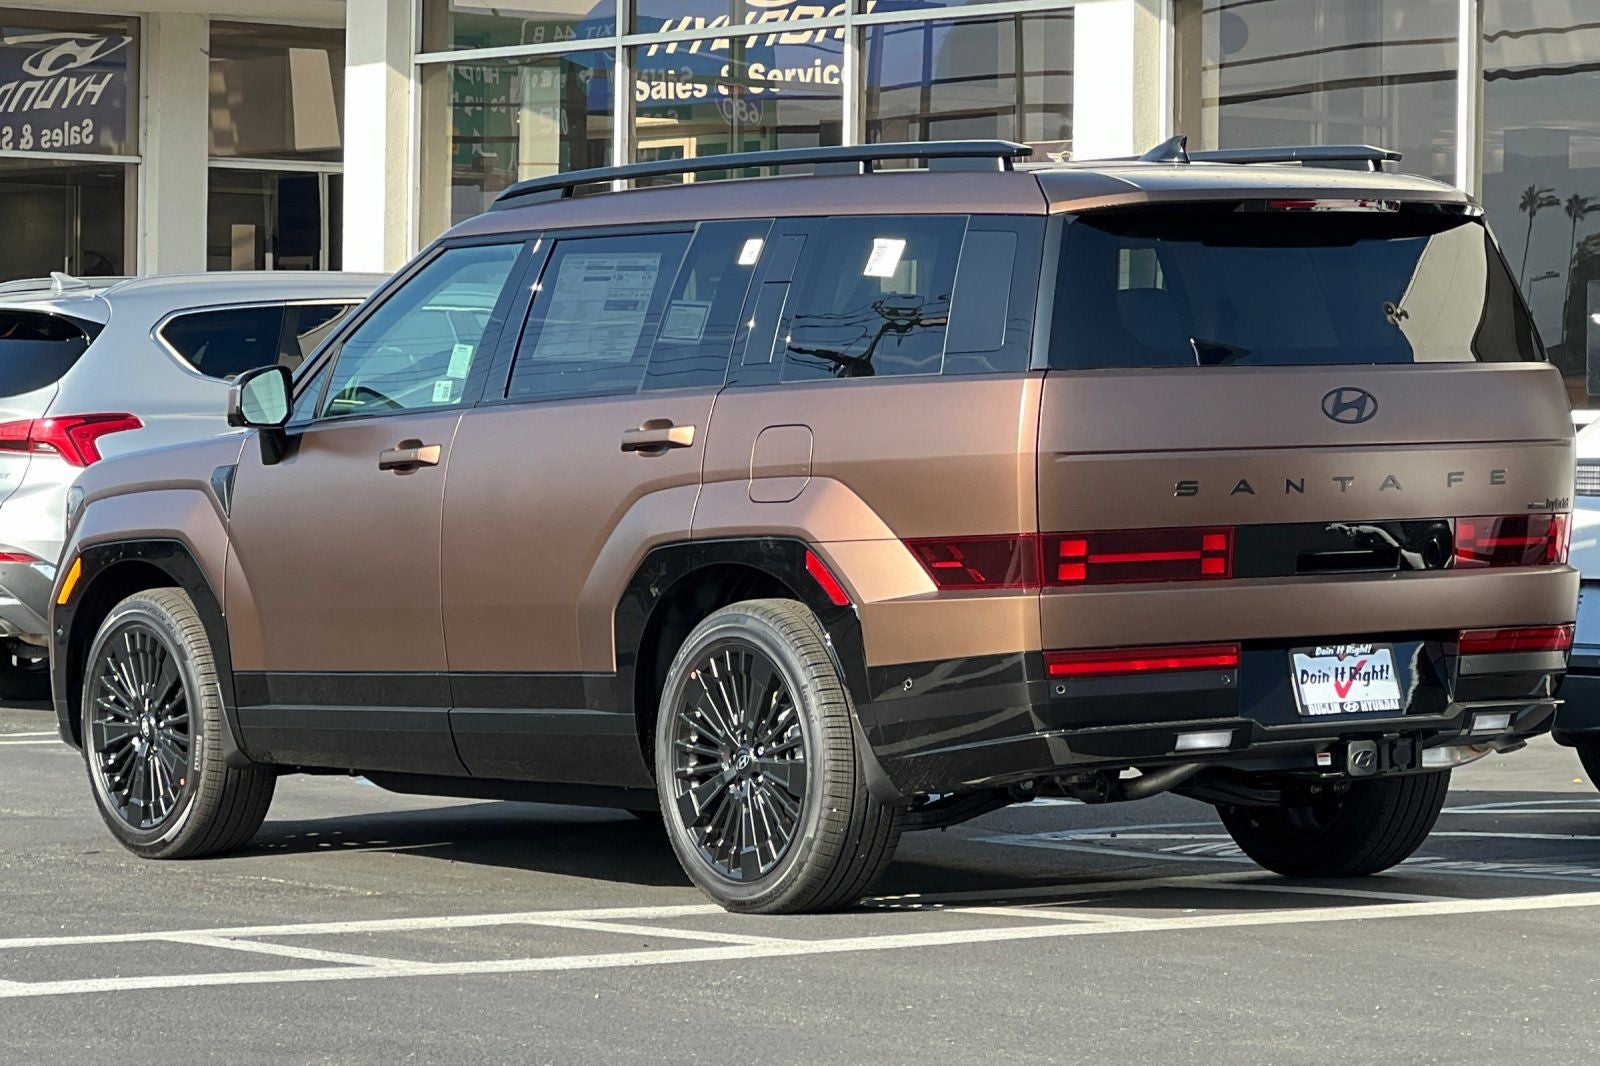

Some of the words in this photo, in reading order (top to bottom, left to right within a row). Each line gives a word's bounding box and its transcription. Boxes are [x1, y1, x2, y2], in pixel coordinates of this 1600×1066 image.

[748, 58, 845, 93] Servic
[1173, 475, 1402, 497] SANTA
[1447, 468, 1508, 488] FE
[1346, 643, 1372, 657] Right!
[1334, 667, 1346, 682] It
[1349, 664, 1390, 687] Right!
[1361, 699, 1400, 712] HYUNDAI
